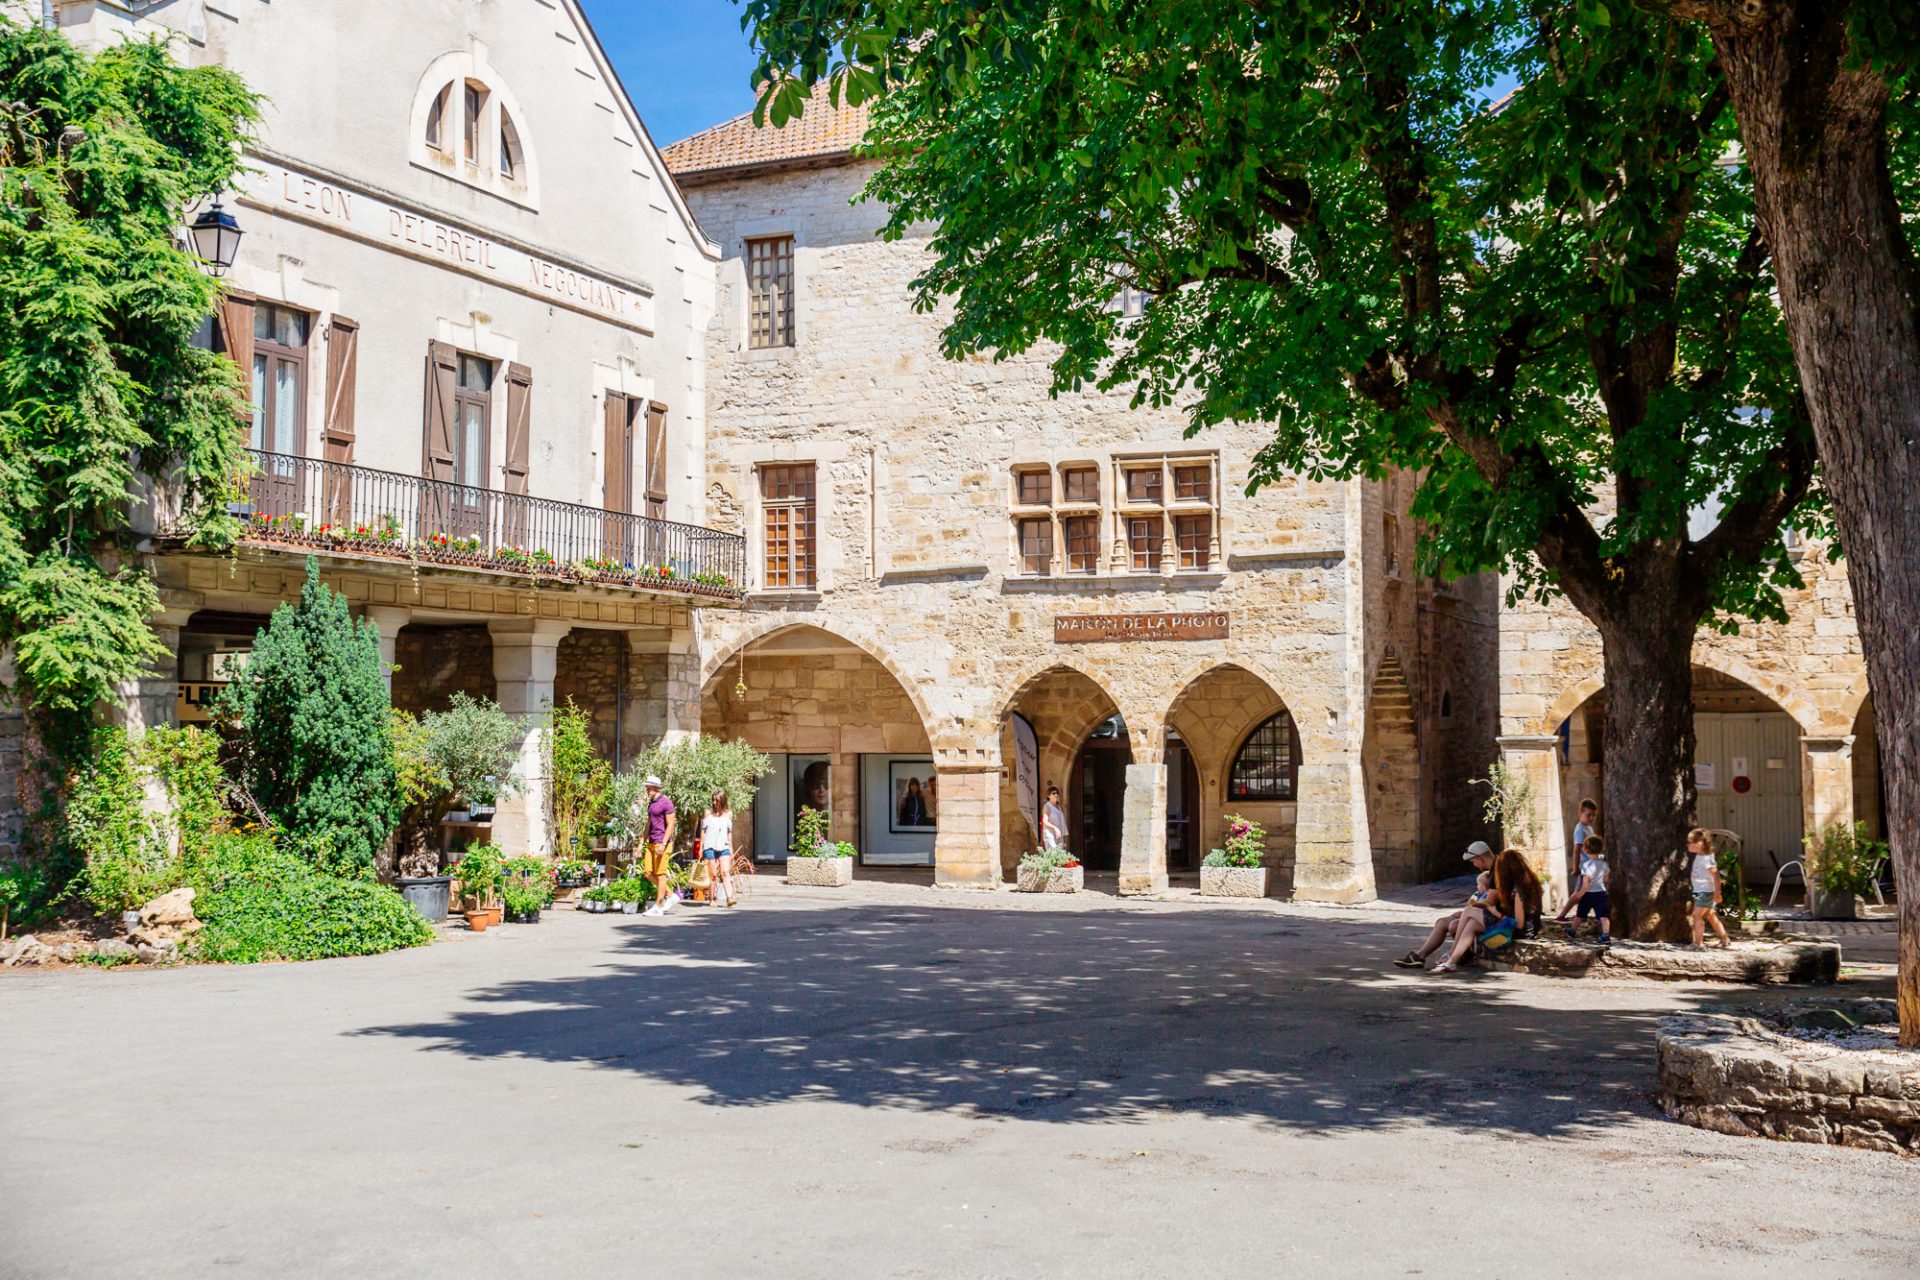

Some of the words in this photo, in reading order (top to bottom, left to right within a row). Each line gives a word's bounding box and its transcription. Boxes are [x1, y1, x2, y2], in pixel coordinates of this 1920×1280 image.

[284, 172, 351, 221] LEON
[389, 209, 497, 270] DELBREIL
[529, 258, 627, 314] NEGOCIANT
[1056, 618, 1117, 630] MAISON
[1123, 617, 1143, 629] DE
[1147, 617, 1166, 629] LA
[1171, 615, 1227, 628] PHOTO
